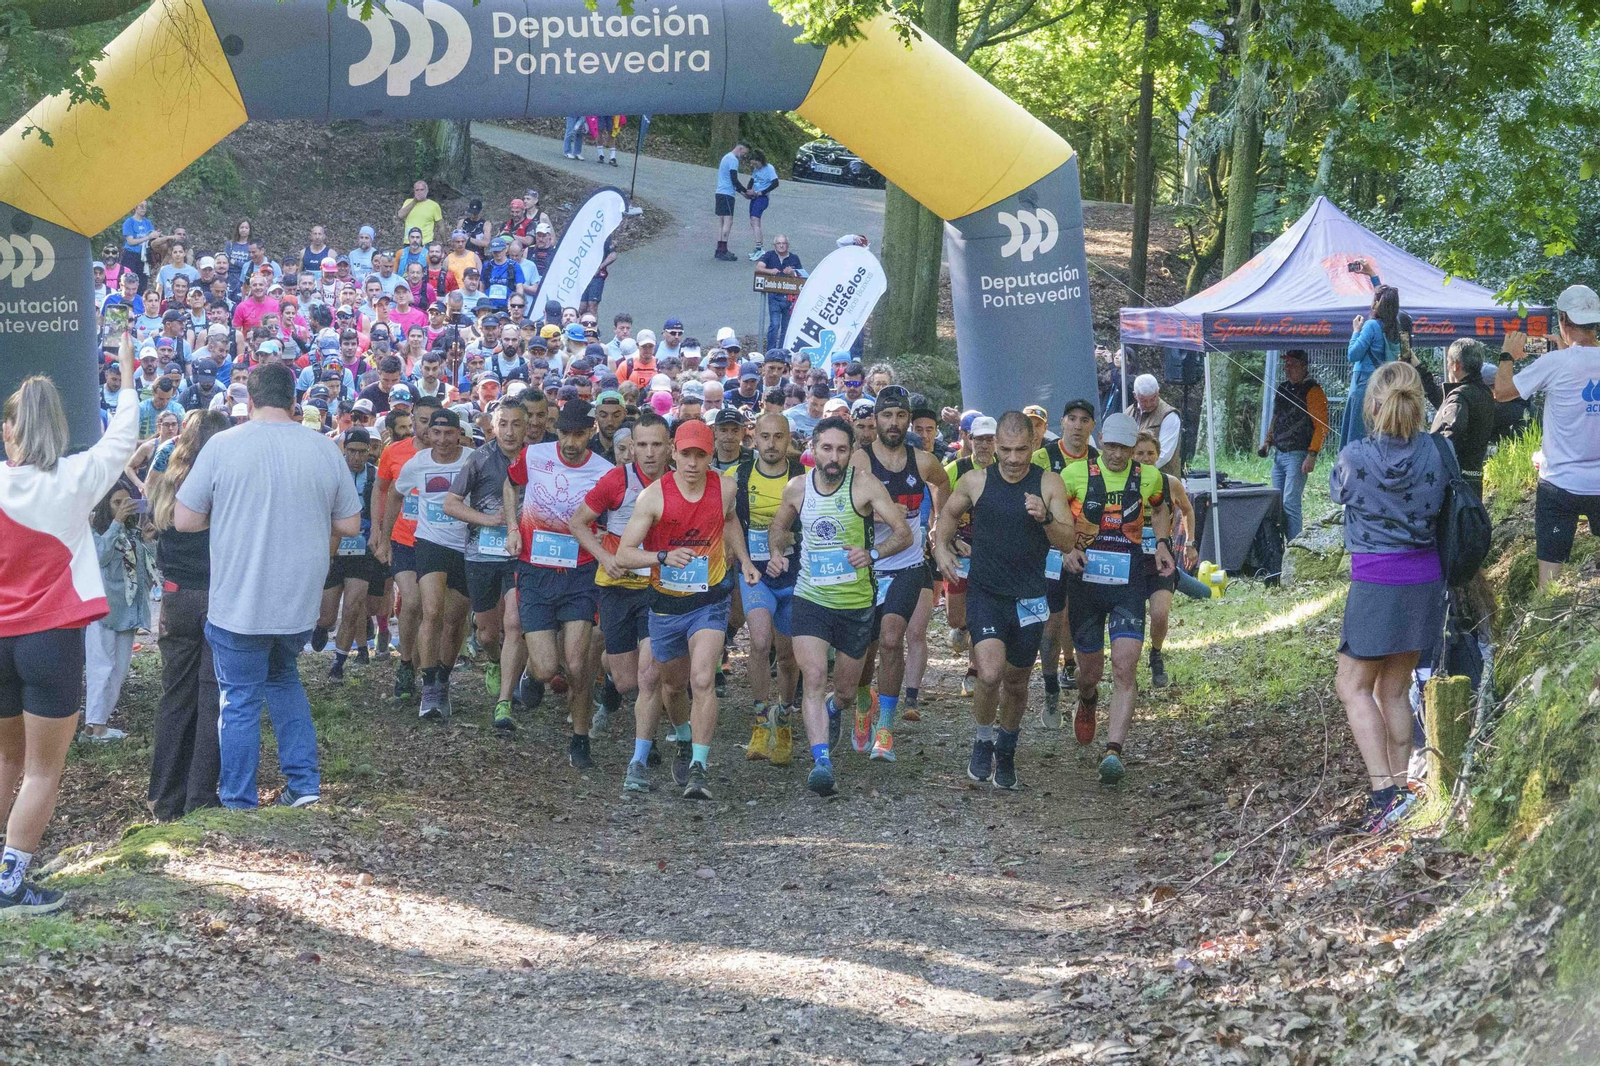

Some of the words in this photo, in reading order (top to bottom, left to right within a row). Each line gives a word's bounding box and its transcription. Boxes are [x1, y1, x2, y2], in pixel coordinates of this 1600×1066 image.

[492, 5, 710, 48] Deputación
[493, 44, 711, 75] Pontevedra
[556, 210, 605, 302] riasbaixas
[981, 264, 1080, 294] Deputación
[811, 295, 827, 315] Trail
[819, 283, 845, 321] Entre
[828, 266, 866, 325] Castelos
[982, 286, 1081, 309] Pontevedra
[341, 540, 357, 549] 272
[549, 545, 561, 556] 51
[671, 570, 696, 582] 347
[819, 562, 844, 575] 454
[1098, 563, 1115, 576] 151
